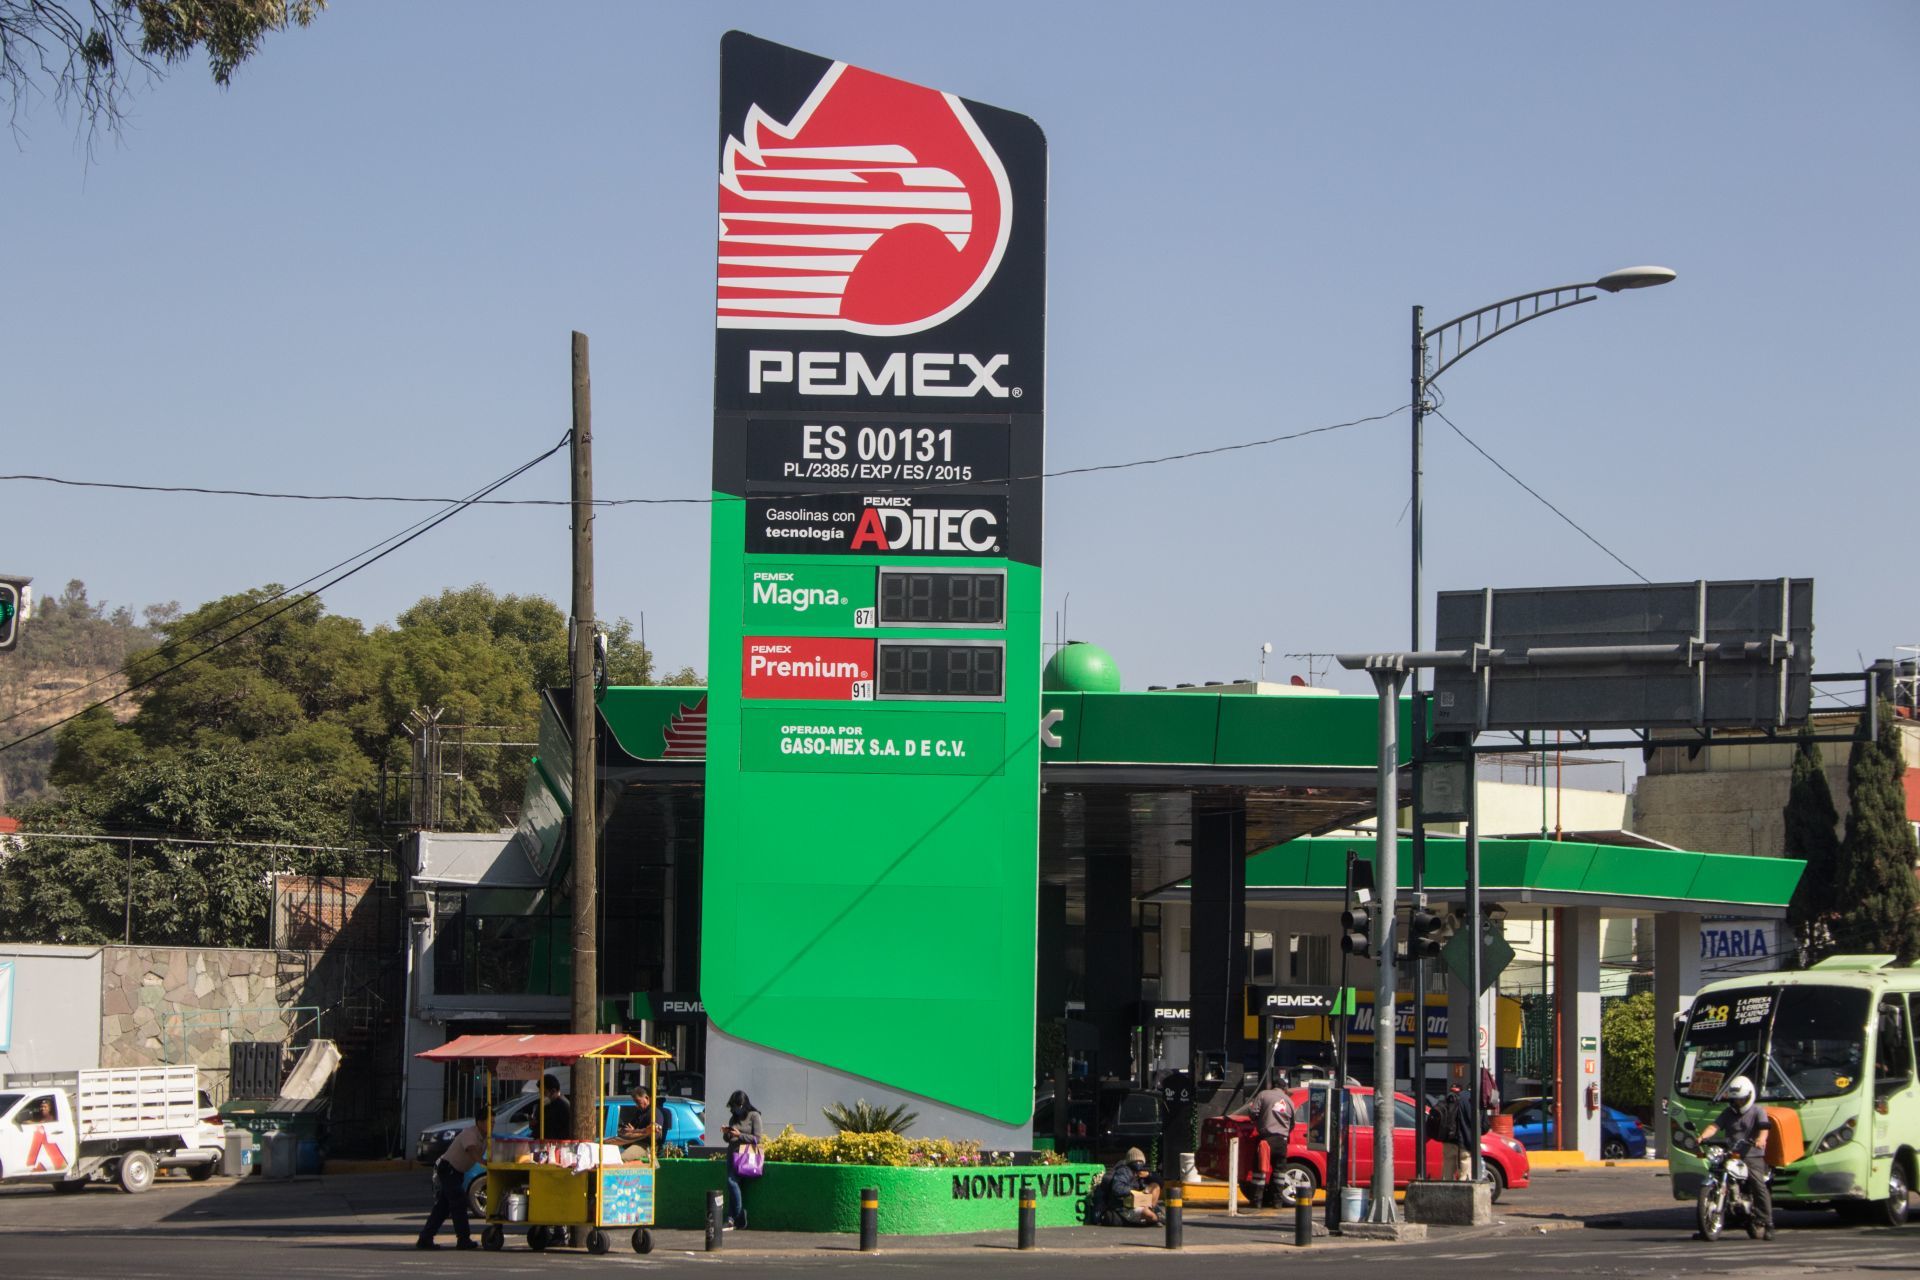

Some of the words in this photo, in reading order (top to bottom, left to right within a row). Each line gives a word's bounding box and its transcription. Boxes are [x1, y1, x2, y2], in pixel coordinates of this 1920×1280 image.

[749, 350, 1009, 397] PEMEX
[803, 425, 847, 460] ES
[857, 427, 952, 462] 00131
[863, 497, 911, 506] PEMEX
[766, 508, 828, 521] Gasolinas
[832, 511, 855, 521] con
[766, 526, 844, 541] tecnología
[753, 572, 794, 581] PEMEX
[753, 582, 839, 611] Magna
[856, 609, 869, 625] 87
[751, 645, 791, 653] PEMEX
[751, 655, 858, 678] Premium
[853, 683, 866, 698] 91
[781, 725, 835, 735] OPERADA
[838, 726, 862, 735] POR
[781, 738, 865, 755] GASO-MEX
[869, 739, 900, 756] S.A.
[935, 740, 966, 757] C.V.
[1266, 995, 1323, 1006] PEMEX
[952, 1173, 1093, 1200] MONTEVIDE
